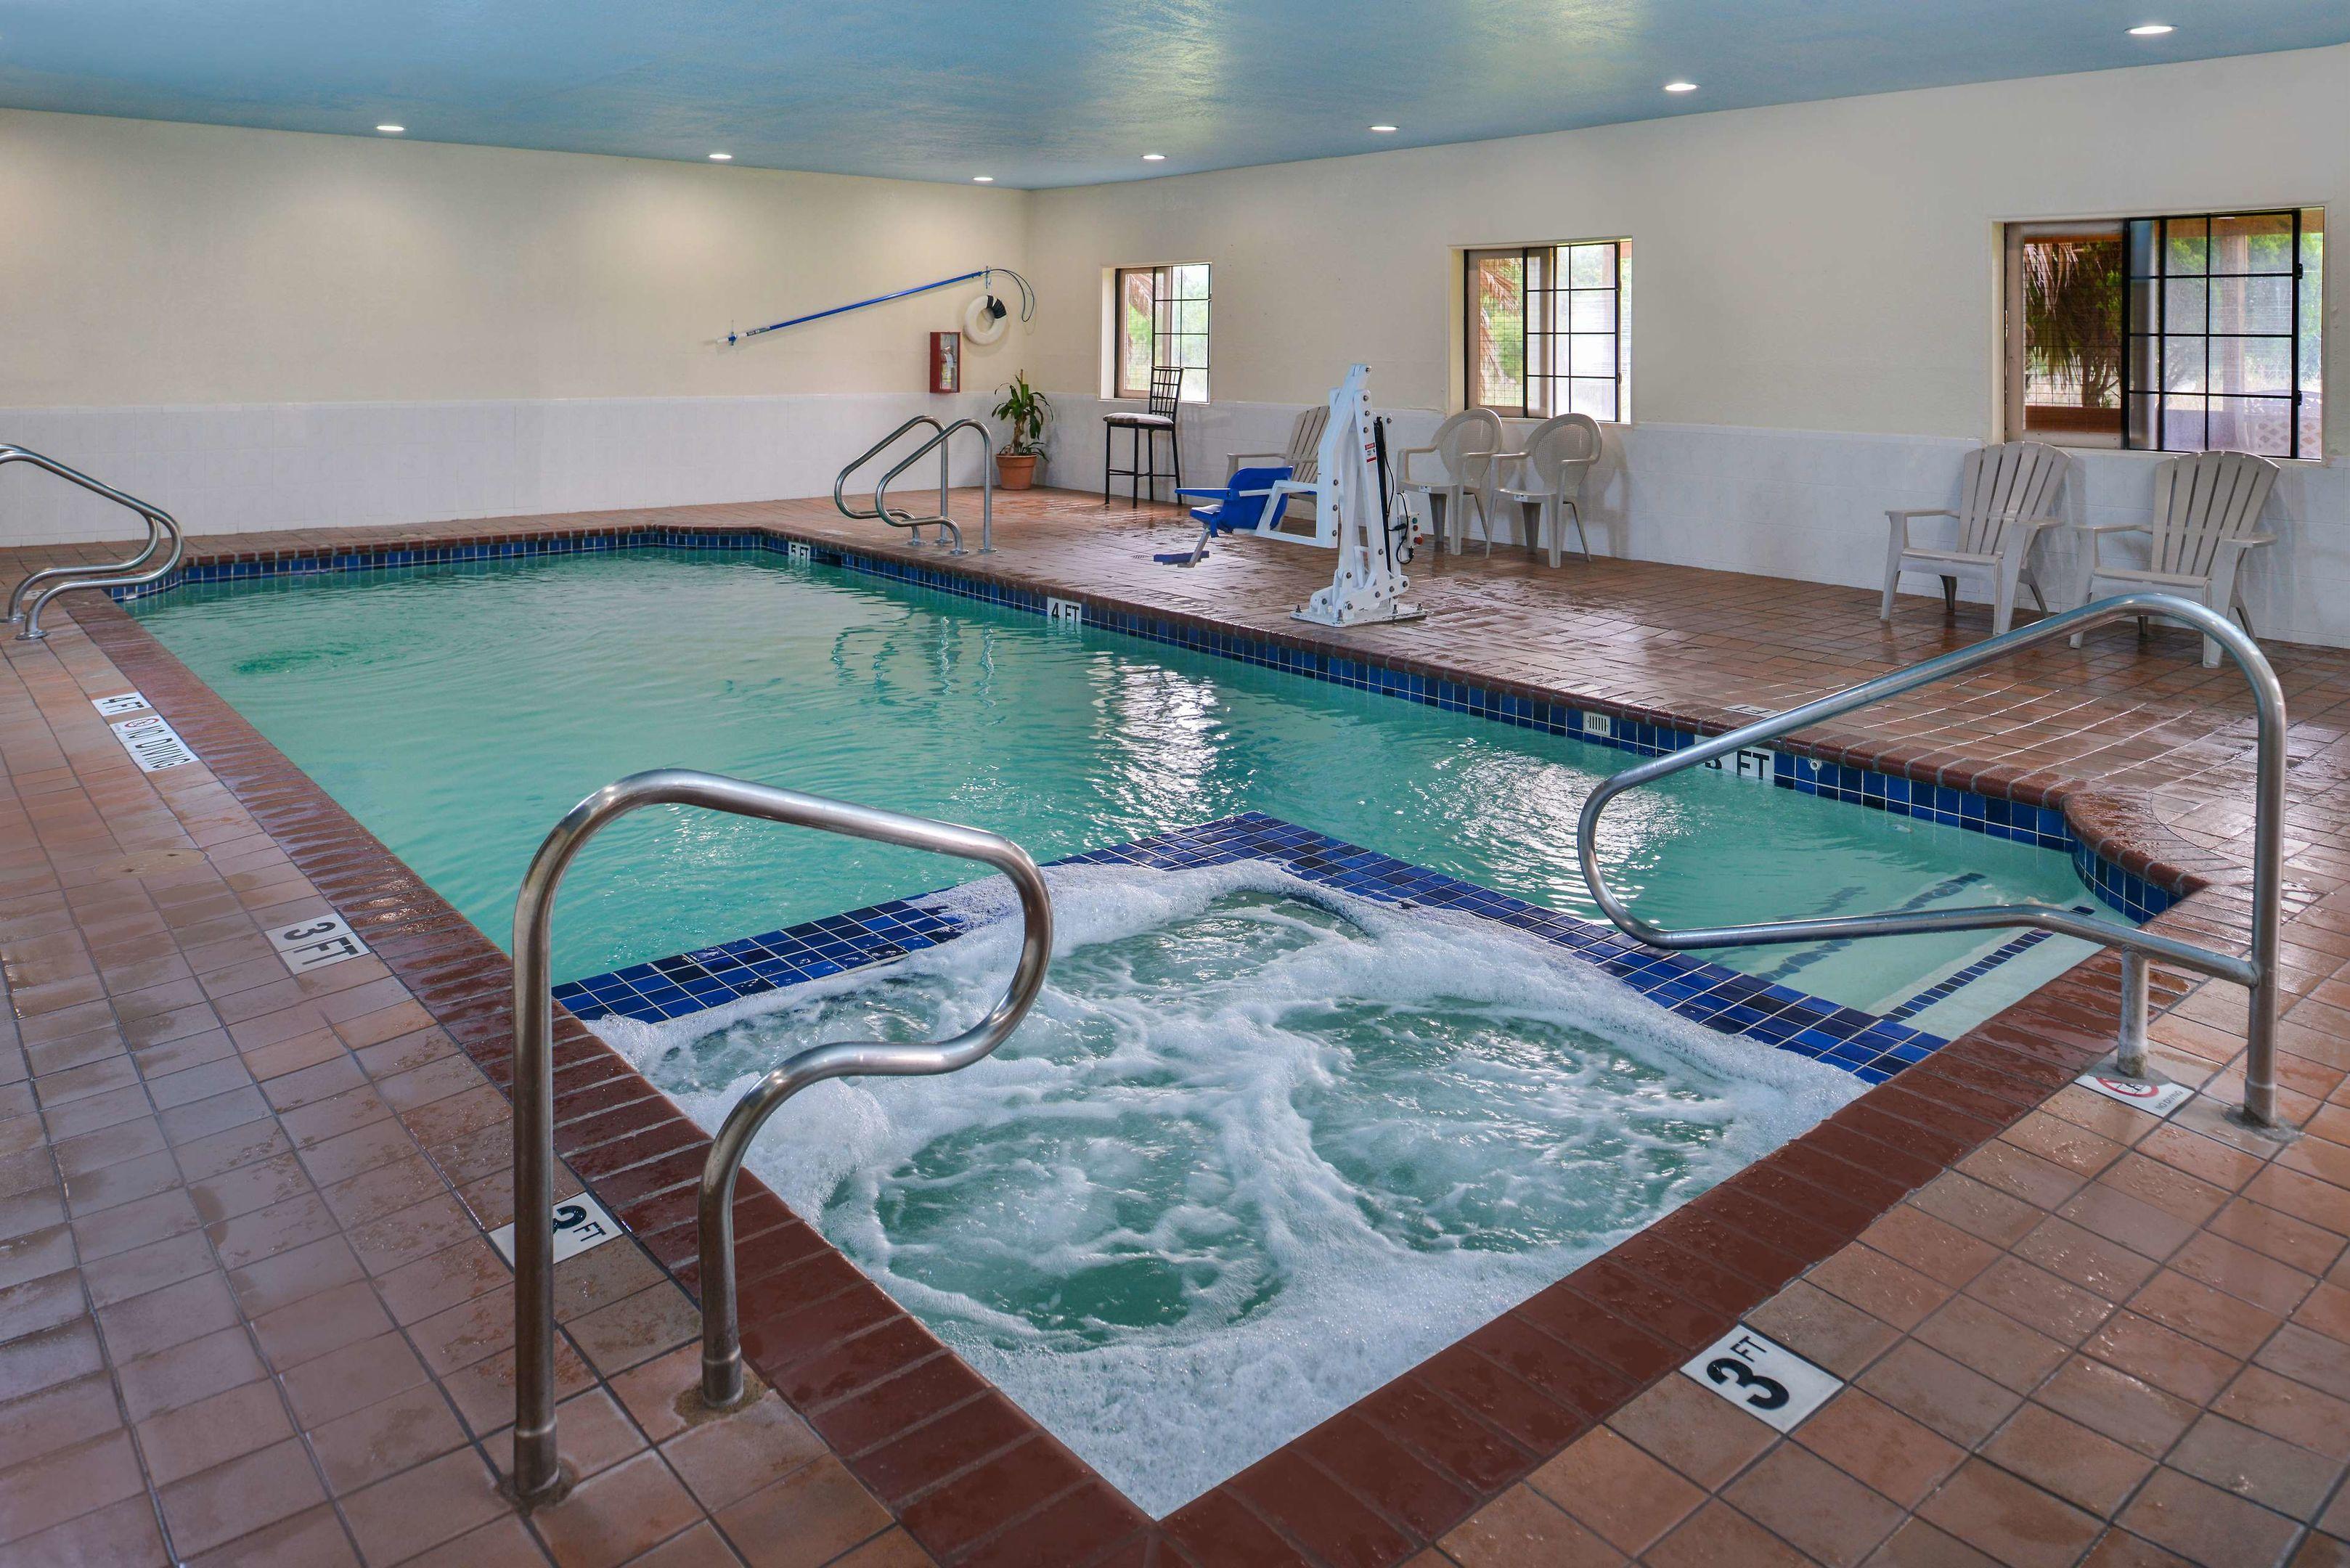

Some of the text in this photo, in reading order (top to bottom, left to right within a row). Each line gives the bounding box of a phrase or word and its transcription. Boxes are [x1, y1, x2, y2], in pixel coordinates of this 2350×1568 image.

[800, 546, 809, 559] FT
[1051, 603, 1080, 622] 4 FT
[102, 696, 144, 713] 4 FT
[124, 724, 191, 769] NO DIVING
[1737, 750, 1770, 780] FT
[283, 921, 359, 965] 3 FT
[2163, 1090, 2184, 1104] DIVING
[573, 1221, 607, 1242] FT
[1707, 1336, 1790, 1410] 3 FT
